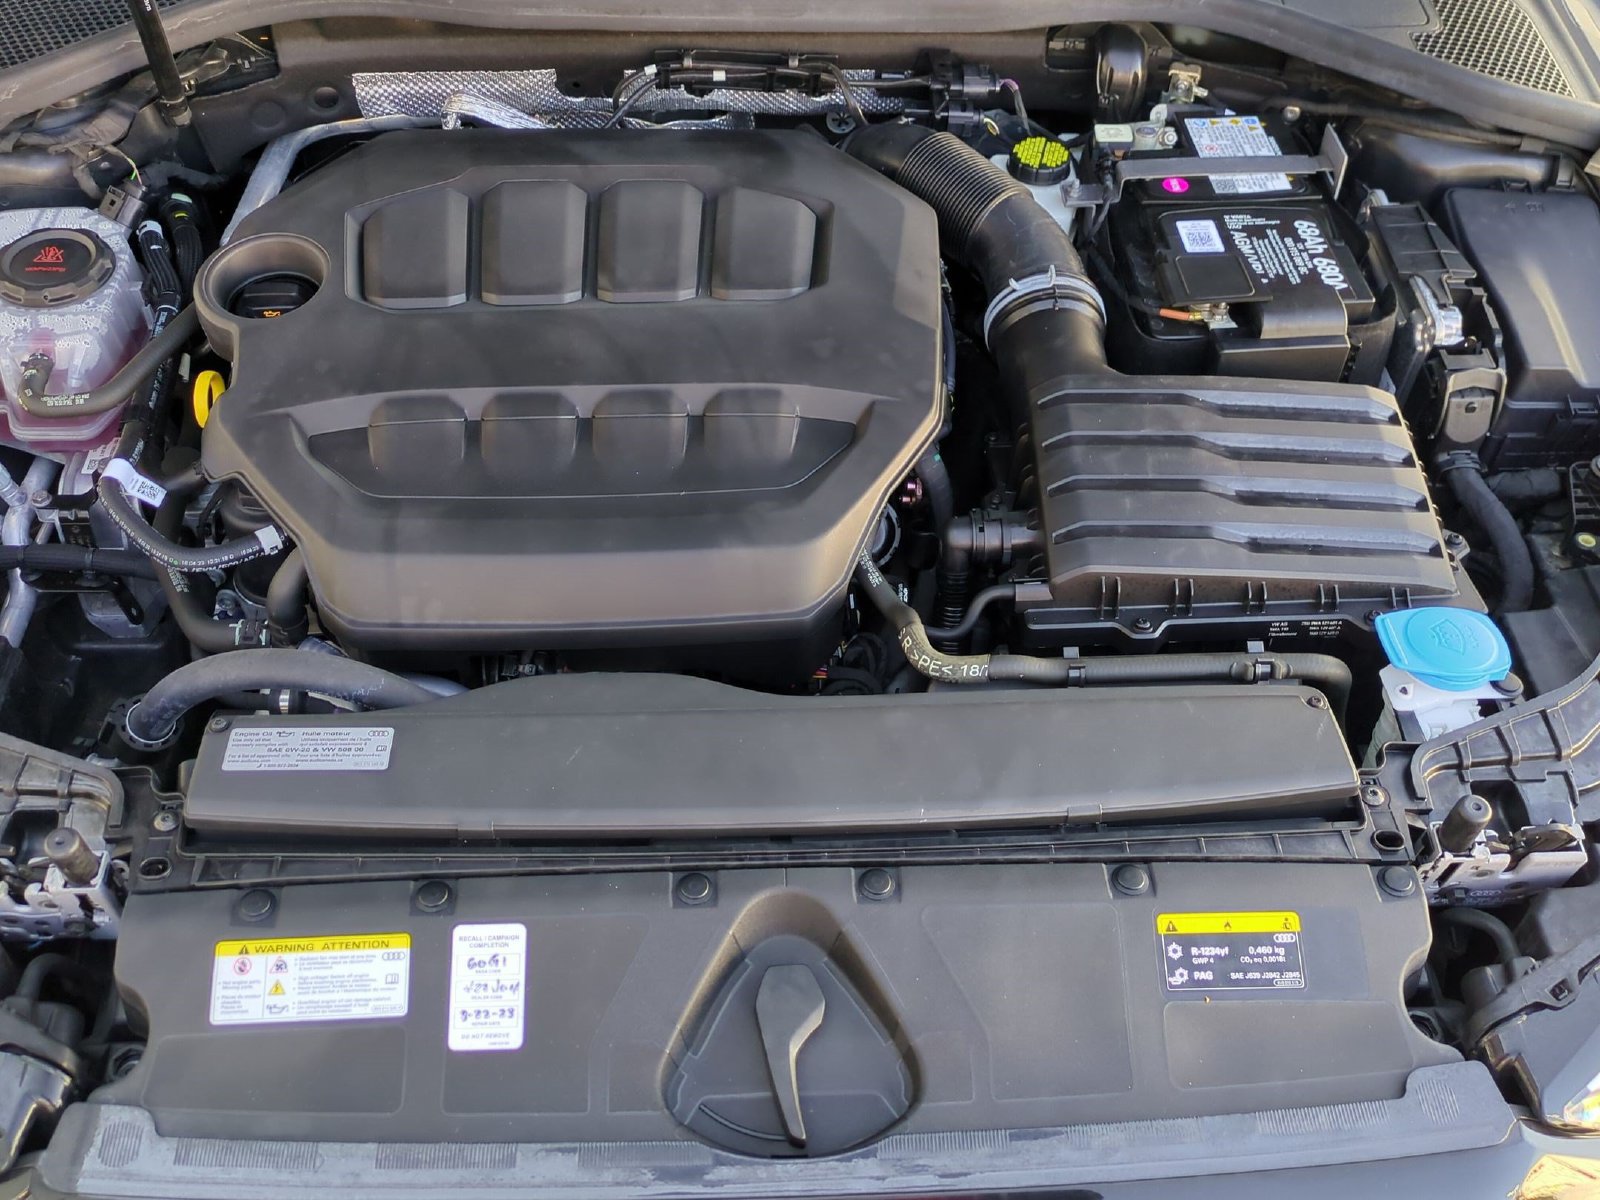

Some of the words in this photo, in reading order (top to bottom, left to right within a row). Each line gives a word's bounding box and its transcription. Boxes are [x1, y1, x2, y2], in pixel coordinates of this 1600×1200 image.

[1294, 220, 1328, 254] 68Ah
[254, 944, 314, 954] WARNING
[322, 940, 390, 951] ATTENTION
[1274, 946, 1285, 956] kg
[1194, 971, 1213, 980] PAG
